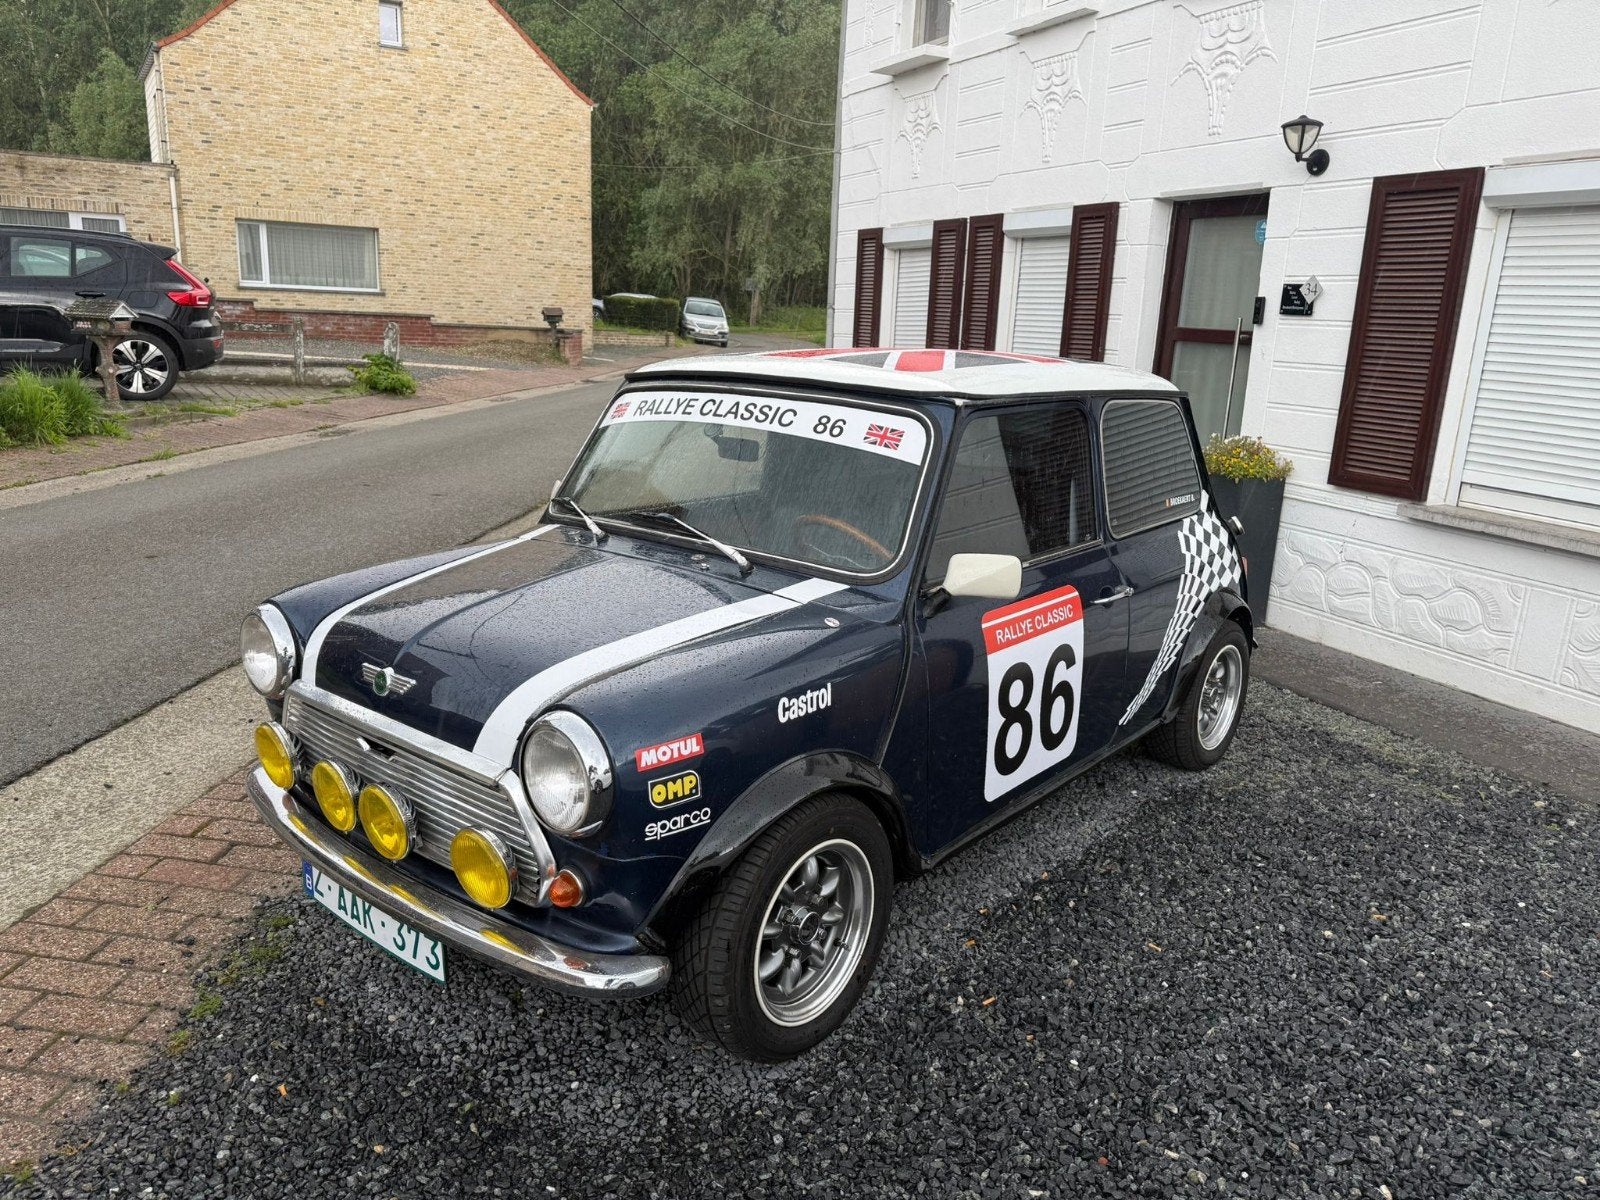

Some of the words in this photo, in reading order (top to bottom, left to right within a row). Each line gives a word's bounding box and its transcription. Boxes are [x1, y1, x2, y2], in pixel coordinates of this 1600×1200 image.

[1304, 282, 1318, 296] 34
[633, 398, 699, 417] RALLYE
[699, 398, 797, 427] CLASSIC
[812, 415, 846, 438] 86
[995, 618, 1033, 645] RALLYE
[1034, 604, 1074, 631] CLASSIC
[777, 682, 832, 723] Castrol
[994, 643, 1076, 776] 86
[640, 737, 700, 767] MOTUL
[644, 807, 711, 841] sparco
